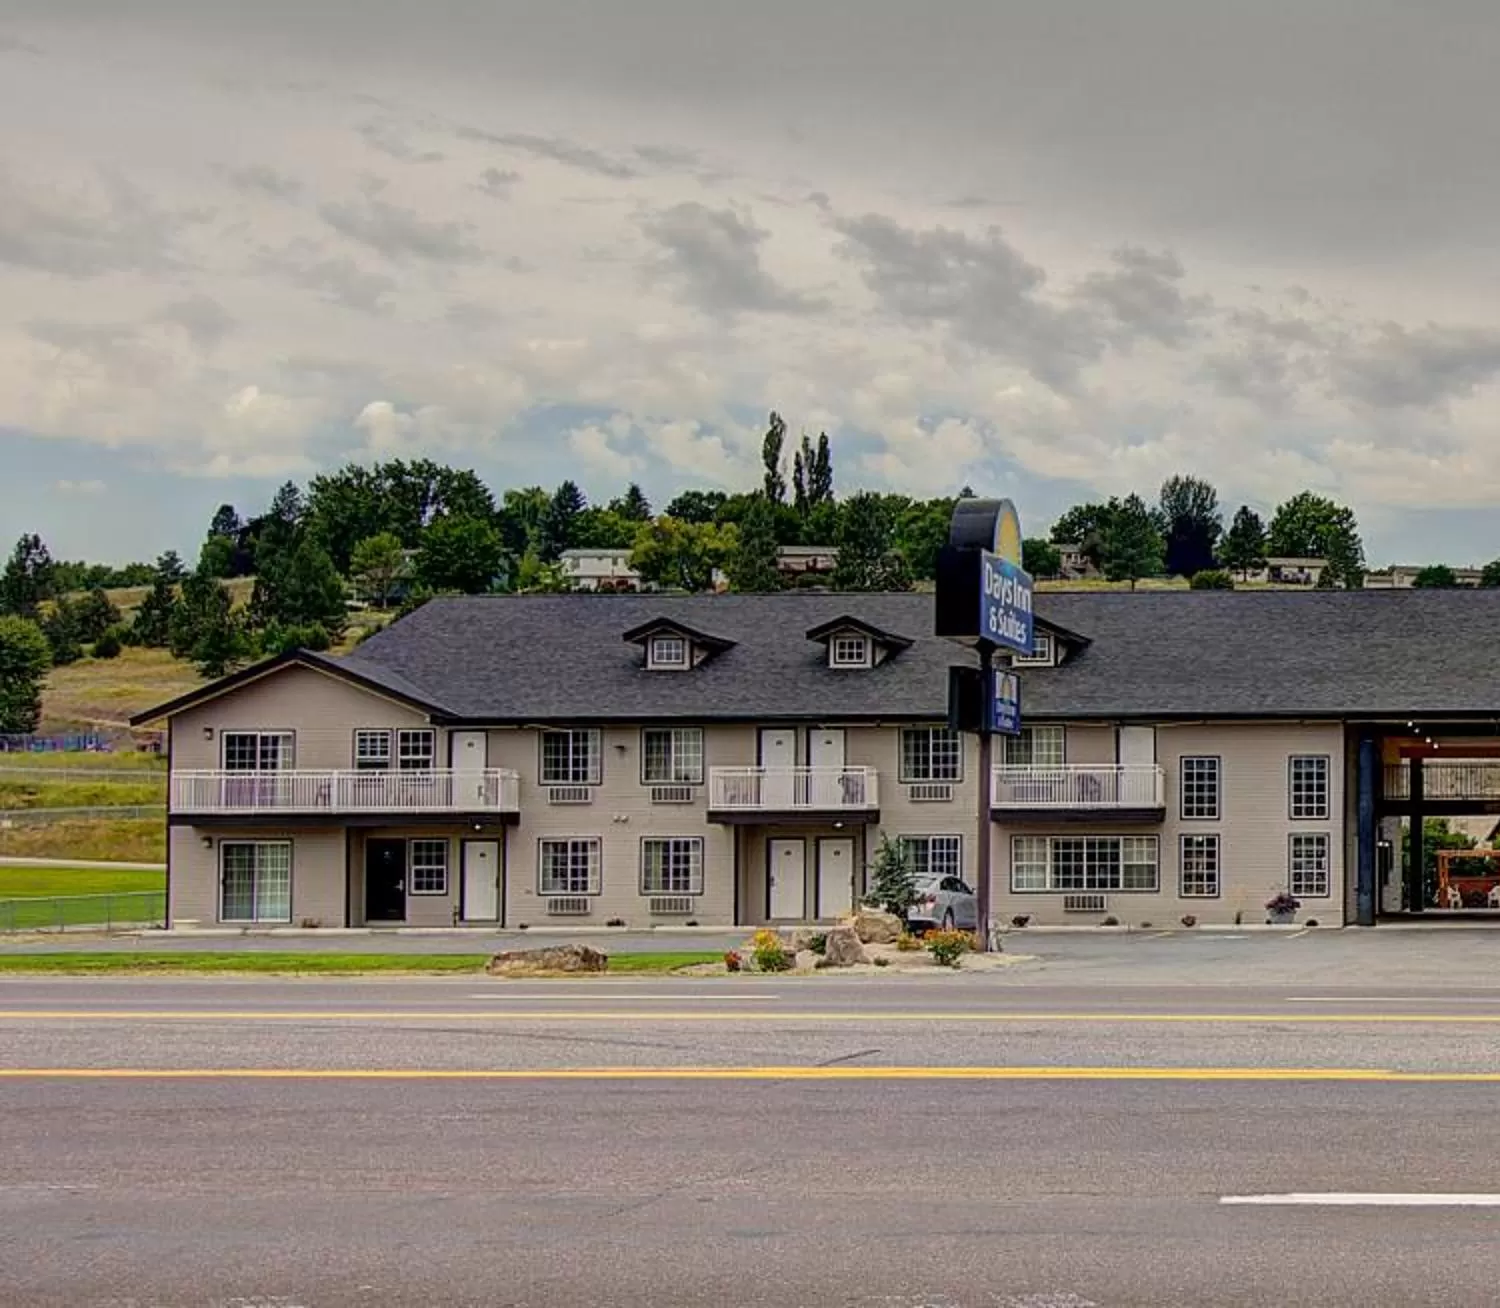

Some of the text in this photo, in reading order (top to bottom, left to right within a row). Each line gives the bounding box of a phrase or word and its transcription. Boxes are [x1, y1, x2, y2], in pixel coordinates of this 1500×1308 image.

[985, 562, 1031, 614] Days Inn
[990, 606, 1027, 644] & Suites
